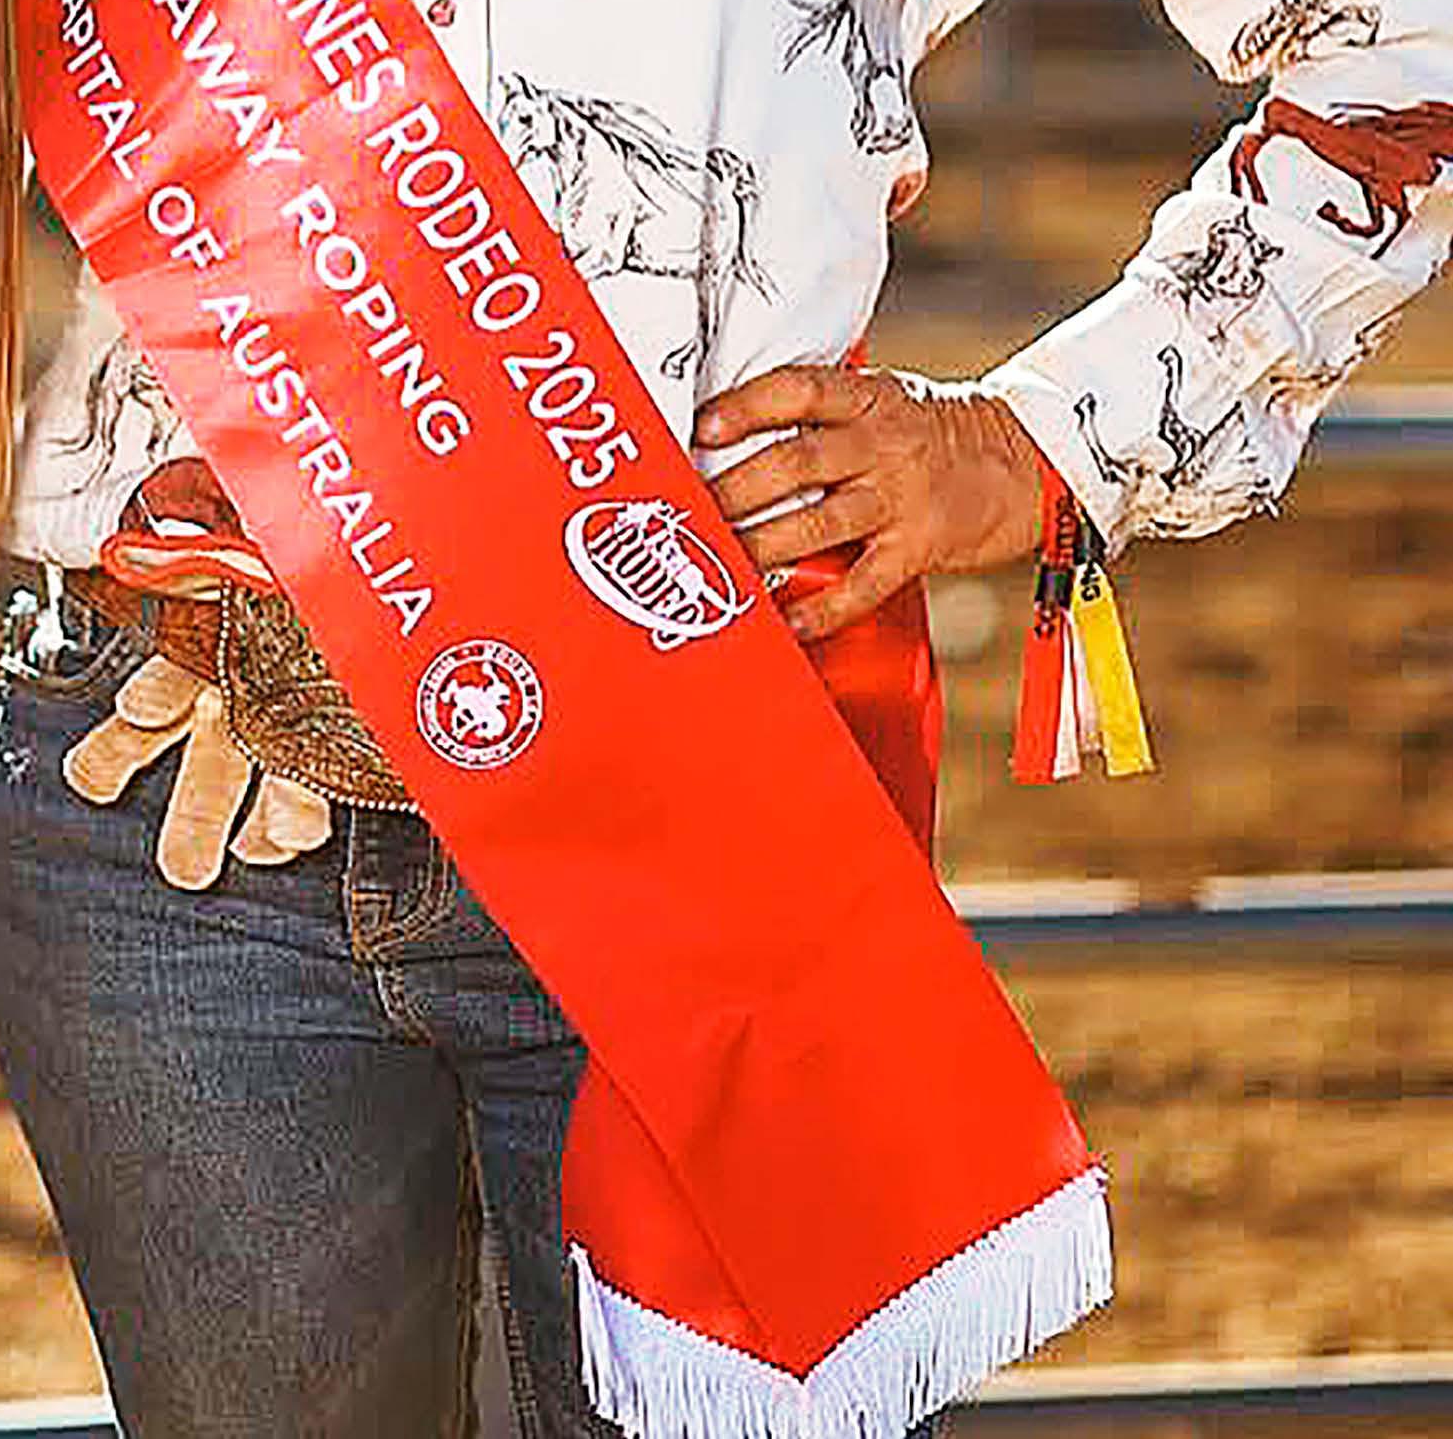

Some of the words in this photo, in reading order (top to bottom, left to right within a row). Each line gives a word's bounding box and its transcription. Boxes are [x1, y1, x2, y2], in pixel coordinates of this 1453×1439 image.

[148, 186, 224, 271] OF
[201, 295, 433, 637] AUSTRALIA
[280, 185, 470, 456] ROPING
[365, 102, 540, 331] RODEO
[505, 331, 638, 490] 2025
